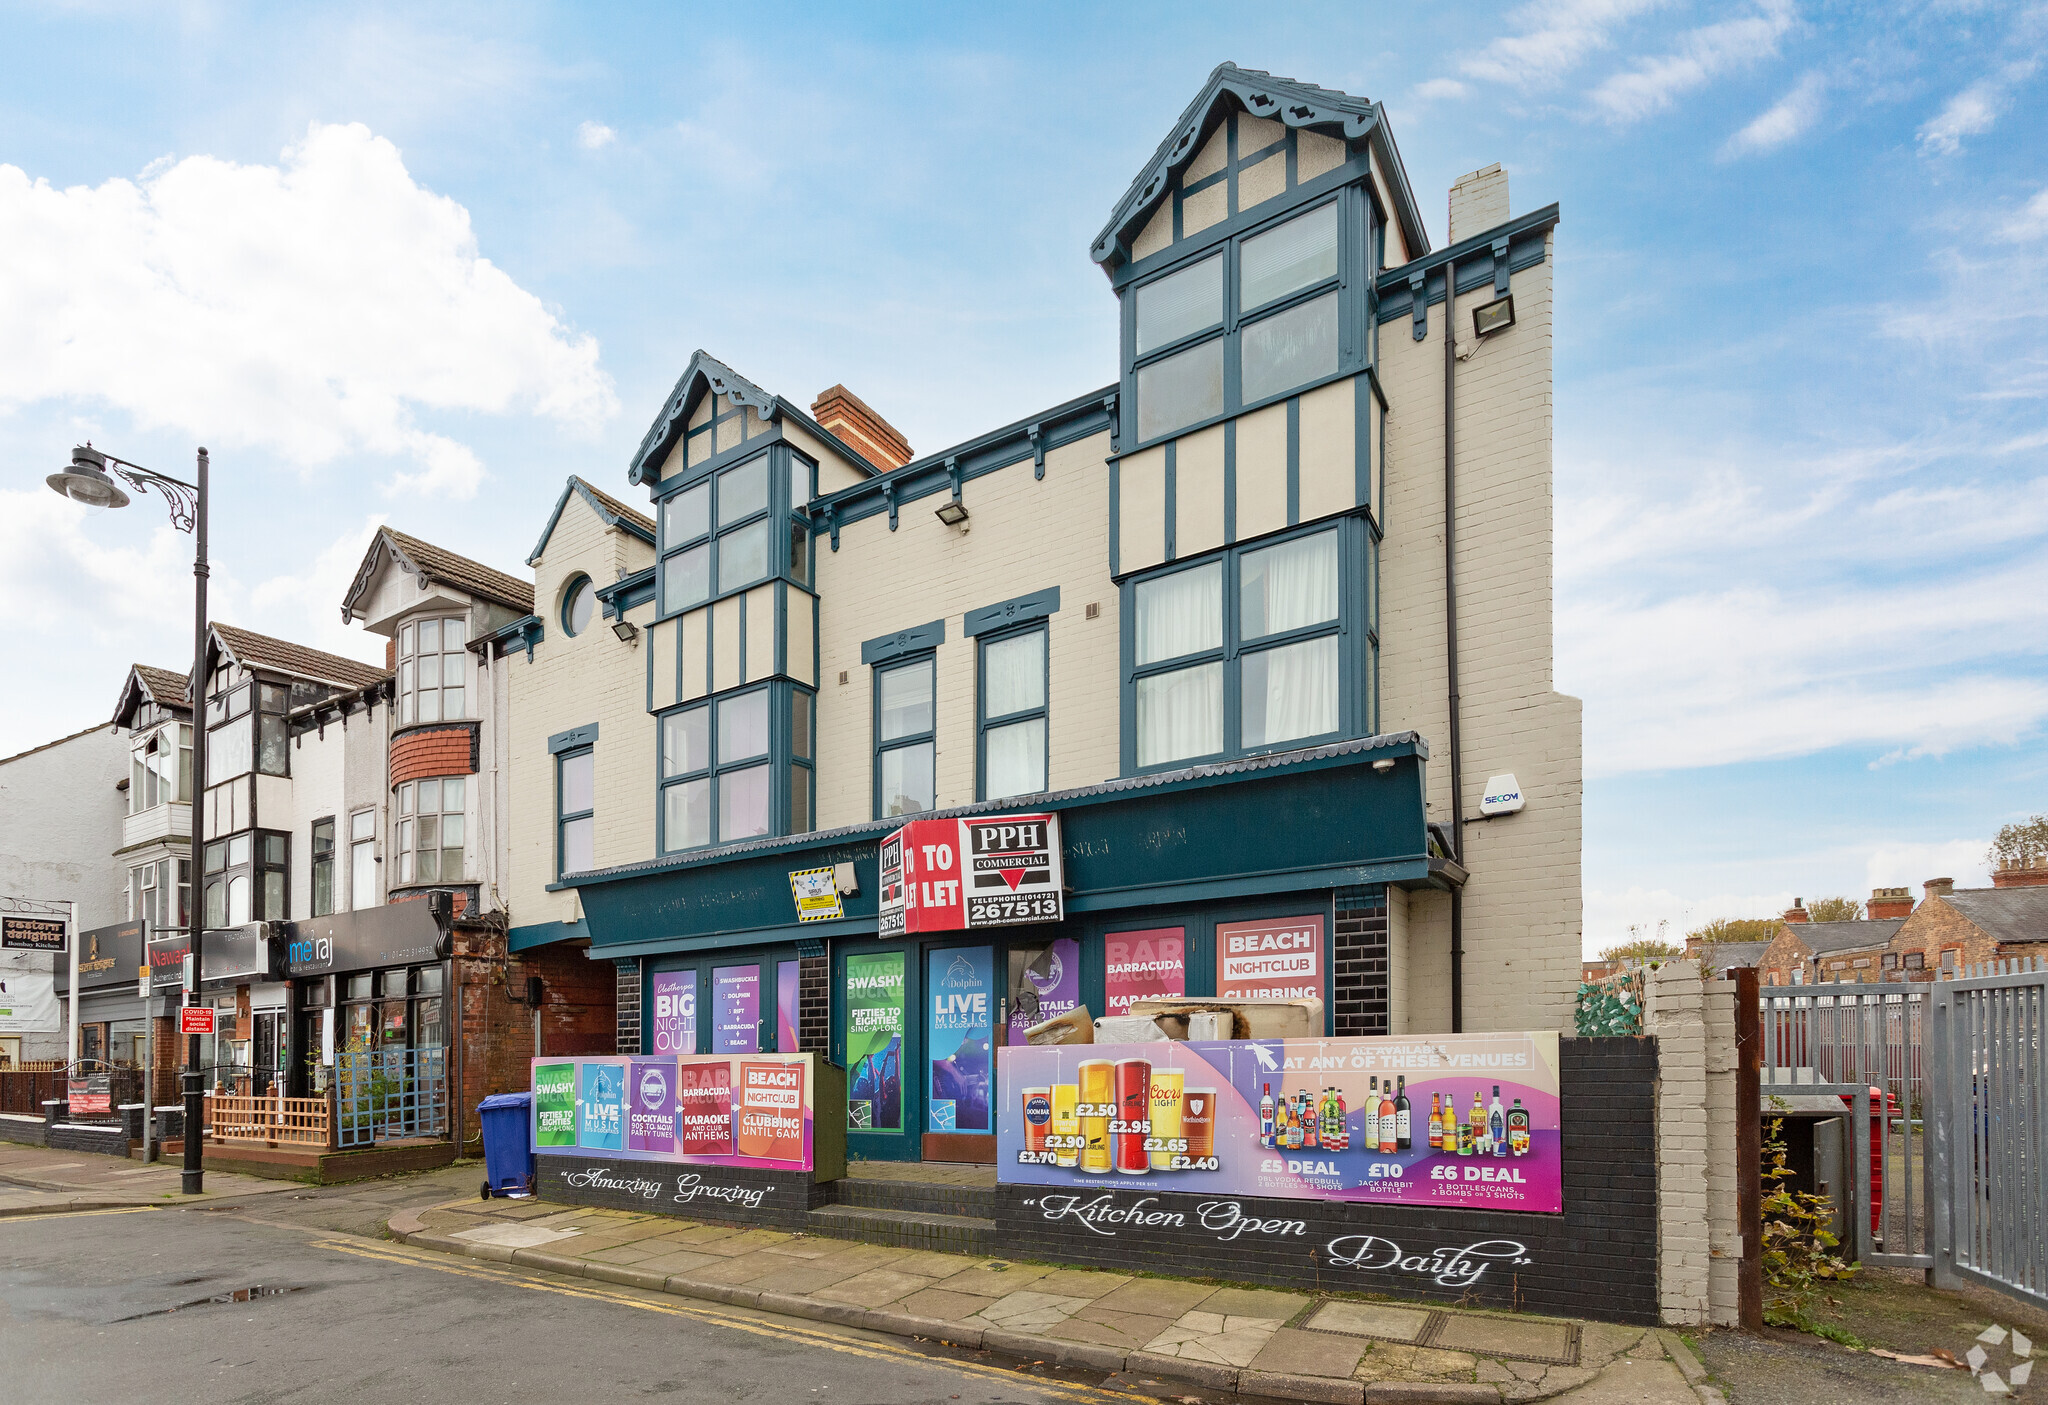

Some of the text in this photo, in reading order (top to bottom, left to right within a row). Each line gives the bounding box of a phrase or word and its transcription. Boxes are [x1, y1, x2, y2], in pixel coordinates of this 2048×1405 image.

[1485, 793, 1518, 804] SECOM
[979, 824, 1040, 850] PPH
[883, 842, 900, 869] PPH
[905, 847, 914, 874] TO
[922, 844, 953, 871] TO
[976, 856, 1046, 869] COMMERCIAL
[905, 882, 917, 910] LET
[922, 880, 959, 908] LET
[971, 900, 1057, 920] 267513
[6, 920, 62, 932] eastern
[880, 912, 904, 931] 267513
[970, 914, 1058, 926] www.pph-commercial.co.uk
[6, 930, 62, 942] delights
[1229, 931, 1310, 953] BEACH
[1107, 959, 1184, 974] BARRACUDA
[1229, 958, 1310, 975] NIGHTCLUB
[720, 976, 758, 984] SWASHBUCKLE
[847, 974, 904, 989] SWASHY
[950, 978, 983, 989] Dolphin
[657, 993, 695, 1017] BIG
[935, 993, 987, 1014] LIVE
[851, 1007, 901, 1018] FIFTIES TO
[935, 1013, 987, 1024] MUSIC
[656, 1017, 694, 1031] NIGHT
[855, 1016, 898, 1026] EIGHTIES
[850, 1024, 902, 1033] SING-A-LONG
[656, 1031, 694, 1050] OUT
[1350, 1045, 1447, 1055] ALL AVAILABLE
[1282, 1053, 1527, 1070] AT ANY OF THESE VENUES
[748, 1072, 797, 1086] BEACH
[536, 1082, 575, 1095] SWASHY
[683, 1087, 731, 1097] BARRACUDA
[1150, 1084, 1181, 1100] Coors
[747, 1092, 796, 1103] NIGHTCLUB
[1154, 1099, 1176, 1107] LIGHT
[539, 1110, 573, 1119] FIFTIES TO
[585, 1102, 619, 1121] LIVE
[1076, 1104, 1117, 1117] £2.50
[542, 1118, 572, 1126] EIGHTIES
[585, 1120, 619, 1130] MUSIC
[631, 1113, 673, 1124] COCKTAILS
[684, 1115, 730, 1125] KARAOKE
[743, 1117, 800, 1129] CLUBBING
[631, 1123, 644, 1131] 90S
[646, 1123, 655, 1131] TO
[742, 1126, 800, 1139] UNTIL 6AM
[1108, 1120, 1151, 1133] £2.95
[685, 1131, 730, 1140] ANTHEMS
[1045, 1136, 1085, 1148] £2.90
[1143, 1138, 1188, 1152] £2.65
[1019, 1151, 1057, 1164] £2.70
[1170, 1156, 1218, 1170] £2.40
[1260, 1159, 1340, 1176] £5 DEAL
[1368, 1163, 1403, 1178] £10
[1430, 1165, 1526, 1183] £6 DEAL
[1197, 1201, 1306, 1240] Open
